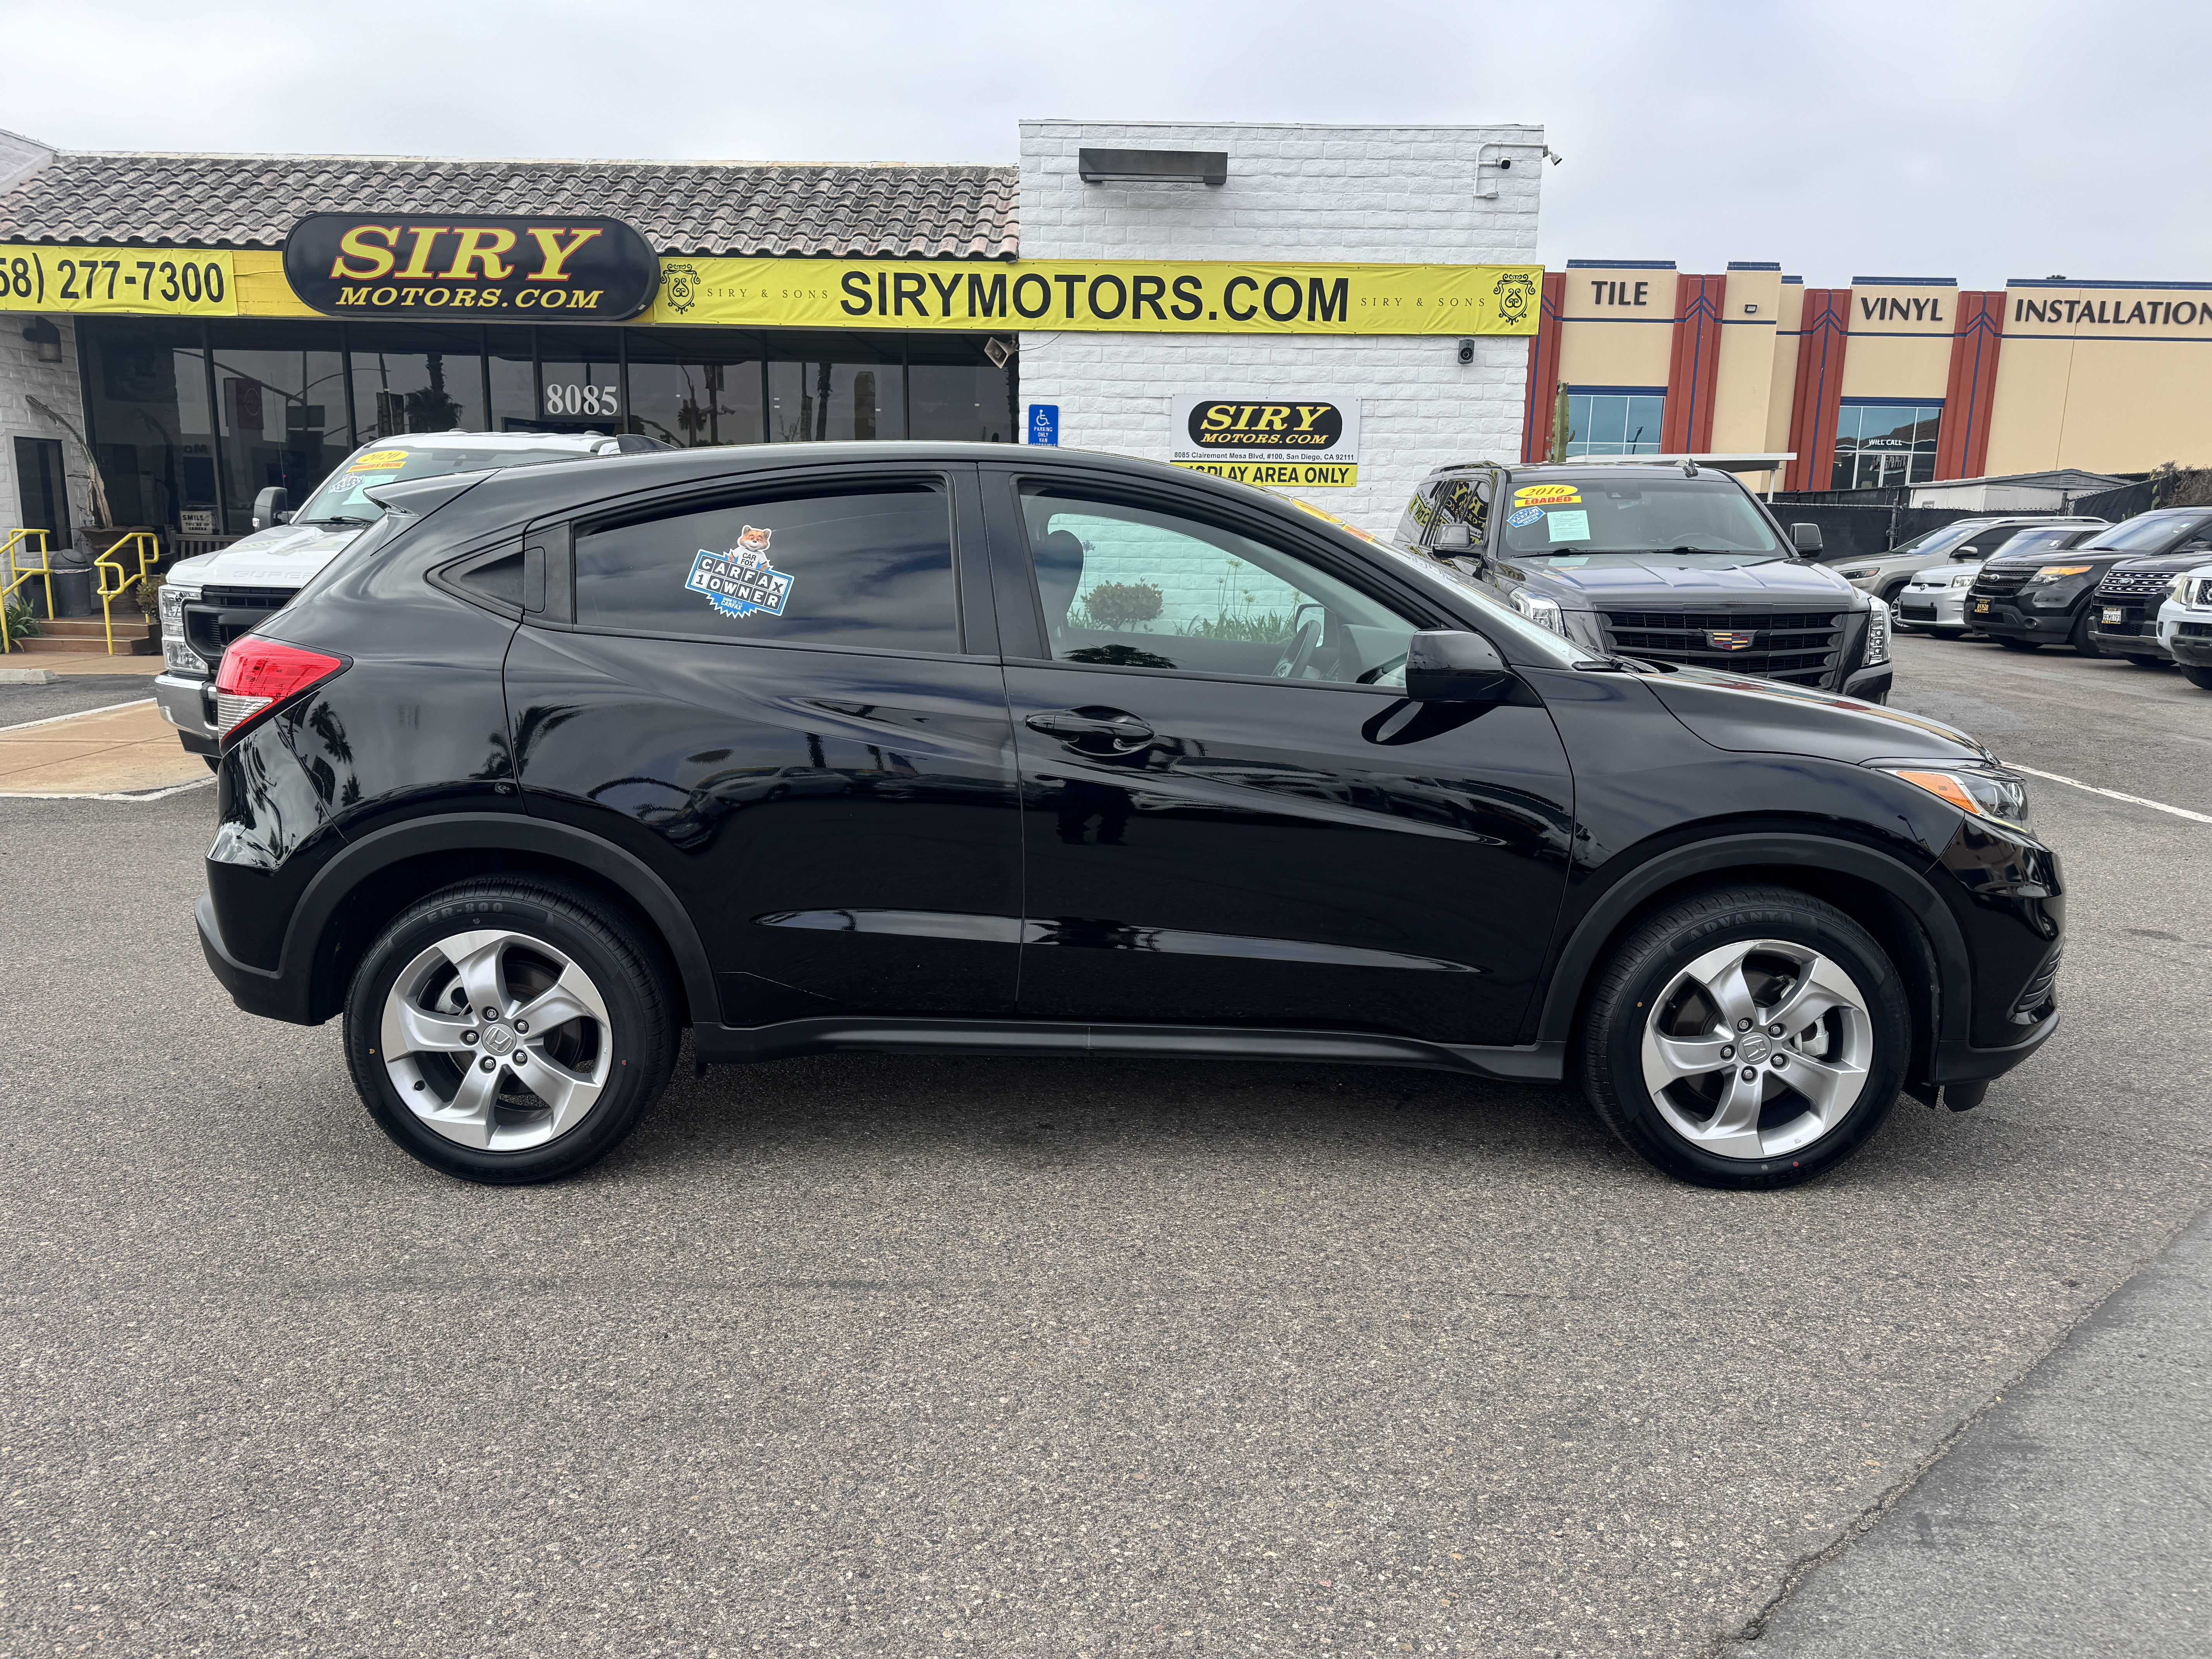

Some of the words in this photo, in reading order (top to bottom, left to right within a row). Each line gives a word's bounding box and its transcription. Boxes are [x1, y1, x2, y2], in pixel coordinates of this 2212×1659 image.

[329, 224, 603, 282] SIRY
[57, 259, 224, 303] 277-7300
[335, 287, 604, 309] MOTORS.COM
[707, 288, 749, 298] SIRY
[782, 289, 829, 300] SONS
[840, 270, 1348, 323] SIRYMOTORS.COM
[1361, 297, 1403, 307] SIRY
[1437, 297, 1486, 307] SONS
[1590, 280, 1649, 306] TILE
[1860, 297, 1943, 322] VINYL
[2014, 299, 2212, 325] INSTALLATION
[546, 384, 618, 416] 8085
[1200, 405, 1331, 431] SIRY
[1200, 433, 1329, 444] MOTORS.COM
[362, 452, 402, 462] 2020
[1252, 466, 1299, 482] AREA
[1305, 467, 1350, 483] ONLY
[1525, 487, 1567, 496] 2016
[1525, 496, 1573, 505] LOADED
[740, 558, 754, 567] FOX
[742, 552, 757, 562] CAR
[701, 558, 784, 593] CARFAX
[695, 574, 704, 586] 1
[709, 579, 778, 607] OWNER
[426, 902, 503, 924] ER-800
[1688, 911, 1794, 942] ADVANTA
